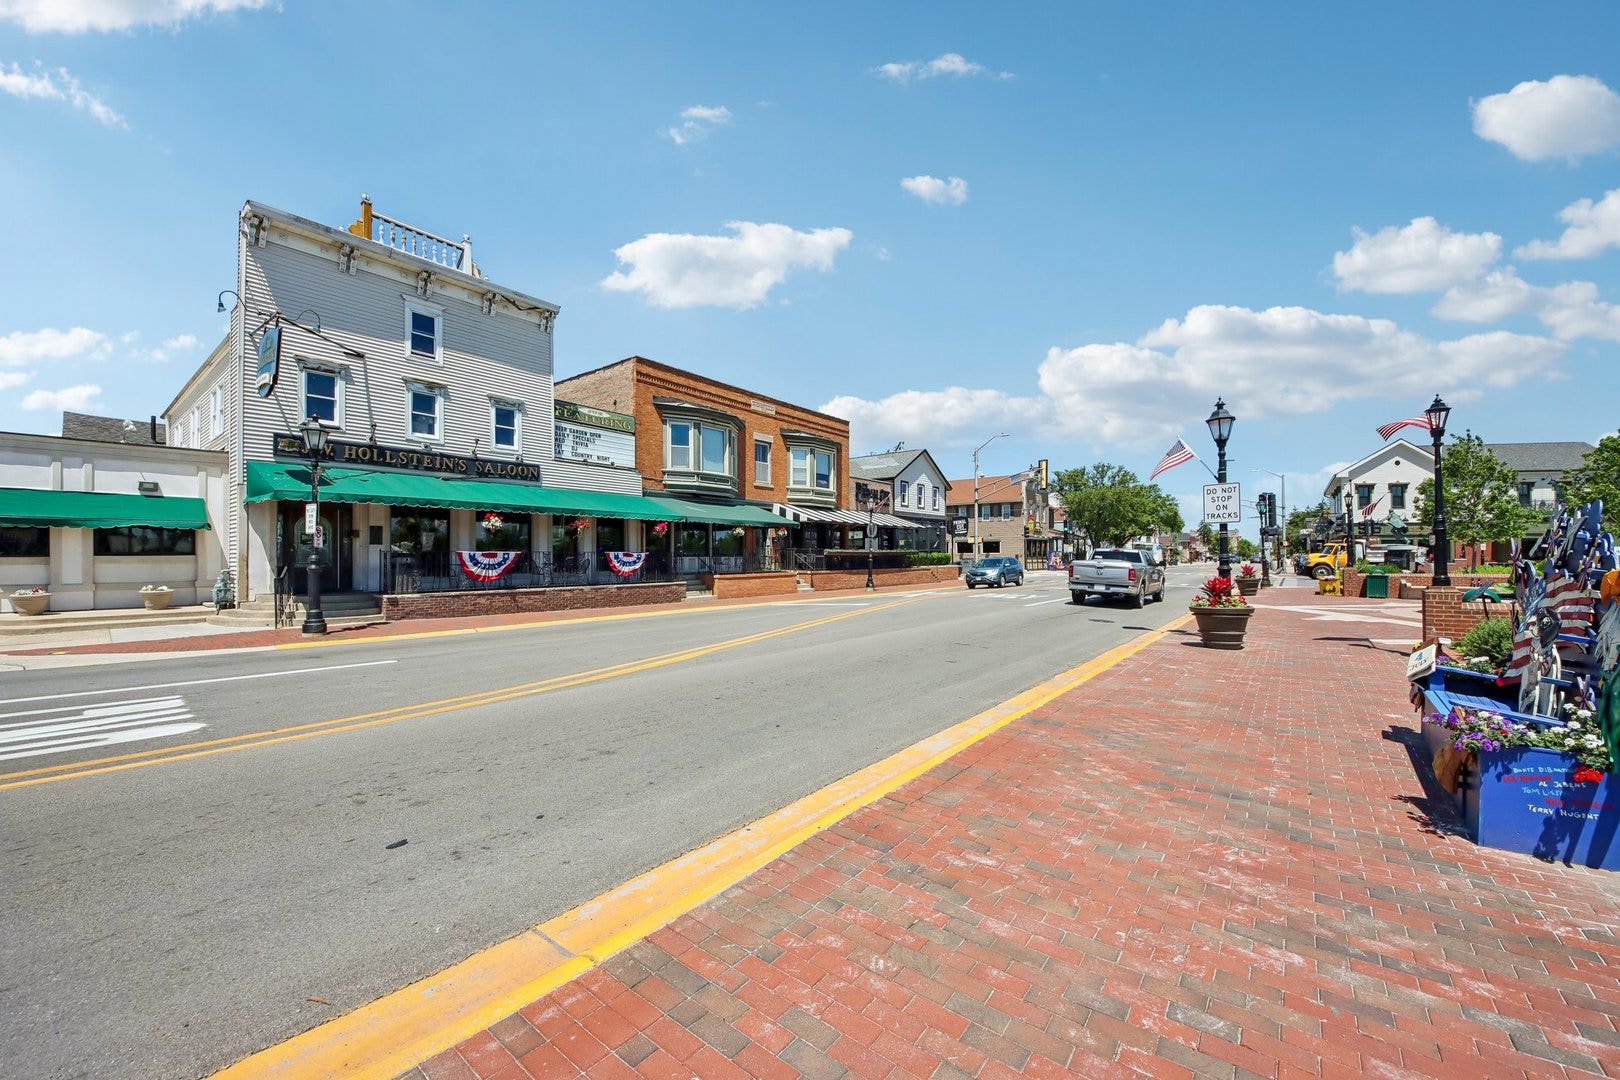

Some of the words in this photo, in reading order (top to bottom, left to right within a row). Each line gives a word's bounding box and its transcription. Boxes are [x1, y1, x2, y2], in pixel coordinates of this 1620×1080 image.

[554, 405, 631, 430] FEATURING
[555, 431, 570, 439] DAILY
[573, 434, 596, 444] SPECIALS
[569, 428, 588, 436] GARDEN
[573, 440, 589, 448] TRIVIA
[344, 445, 467, 471] HOLLSTEIN'S
[474, 461, 538, 477] SALOON
[571, 451, 593, 460] COUNTRY
[1528, 804, 1554, 815] TERRY
